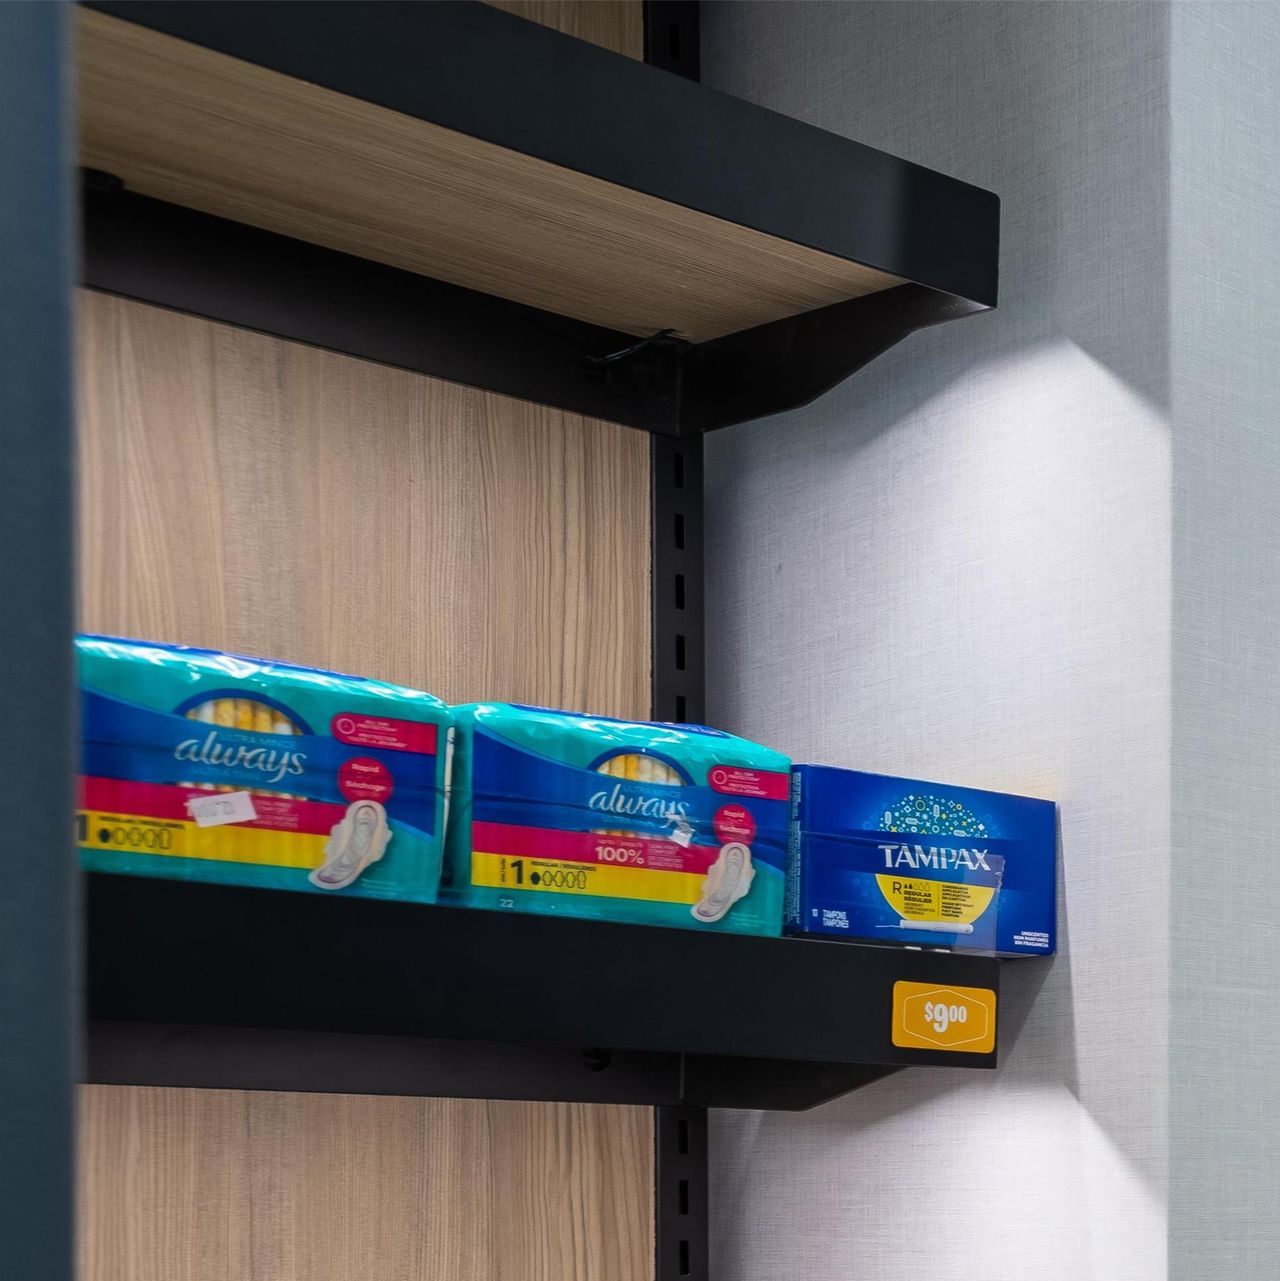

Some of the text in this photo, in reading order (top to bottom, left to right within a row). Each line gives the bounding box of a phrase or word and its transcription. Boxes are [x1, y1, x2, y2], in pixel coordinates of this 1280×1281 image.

[174, 731, 307, 784] always
[595, 846, 645, 865] 100%
[878, 843, 992, 871] TAMPAX
[511, 860, 524, 884] 1
[892, 881, 902, 895] R
[500, 899, 514, 909] 22
